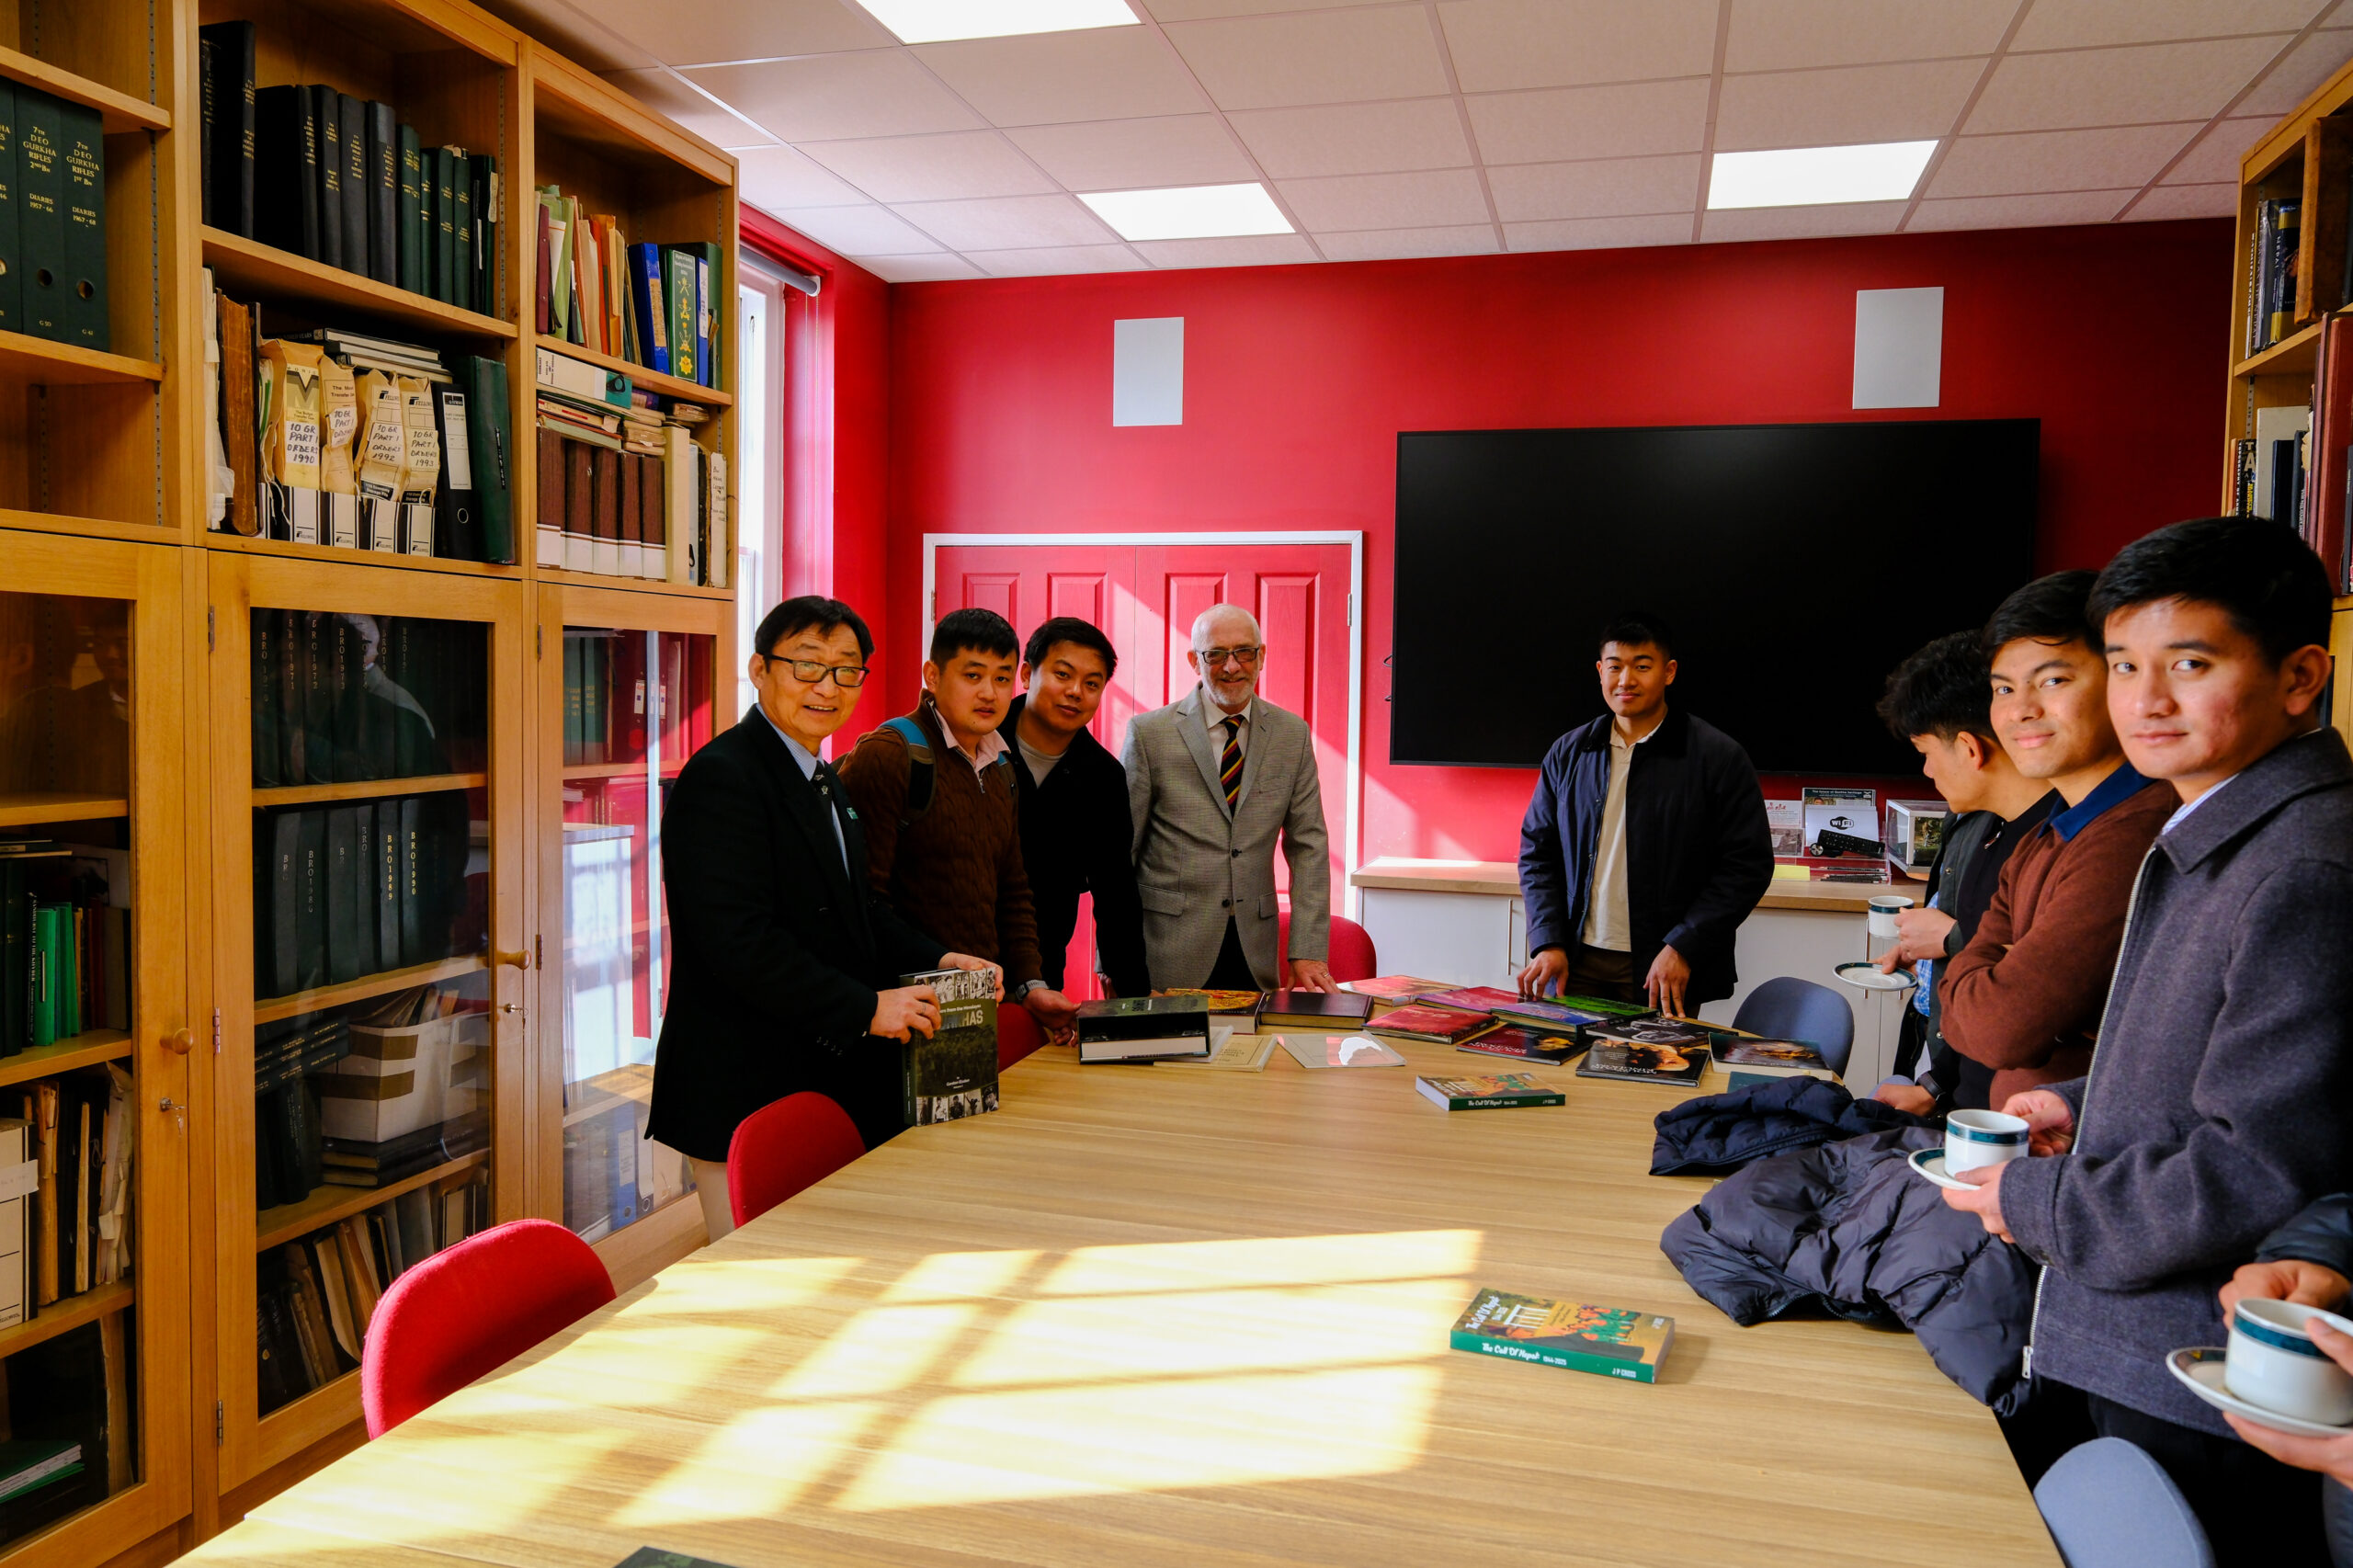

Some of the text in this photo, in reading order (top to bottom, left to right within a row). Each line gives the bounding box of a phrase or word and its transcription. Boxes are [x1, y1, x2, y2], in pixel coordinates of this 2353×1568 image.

[30, 134, 49, 145] DEO
[23, 141, 57, 157] GURKHA
[28, 152, 51, 164] RIFLES
[74, 149, 92, 160] DEO
[66, 155, 100, 171] GURKHA
[72, 165, 95, 177] RIFLES
[29, 193, 53, 205] DIARIES
[73, 206, 96, 218] DIARIES
[290, 423, 316, 433] 10 GR
[378, 425, 386, 433] 10
[290, 432, 313, 442] PART
[373, 433, 393, 441] PART
[287, 444, 318, 454] ORDERS
[372, 444, 401, 452] ORDERS
[293, 454, 315, 463] 1990
[371, 453, 395, 461] 1992
[415, 459, 434, 467] 1993
[1482, 1342, 1493, 1353] The
[1494, 1345, 1508, 1355] Call
[1508, 1346, 1519, 1356] Of
[1620, 1369, 1636, 1378] CROSS
